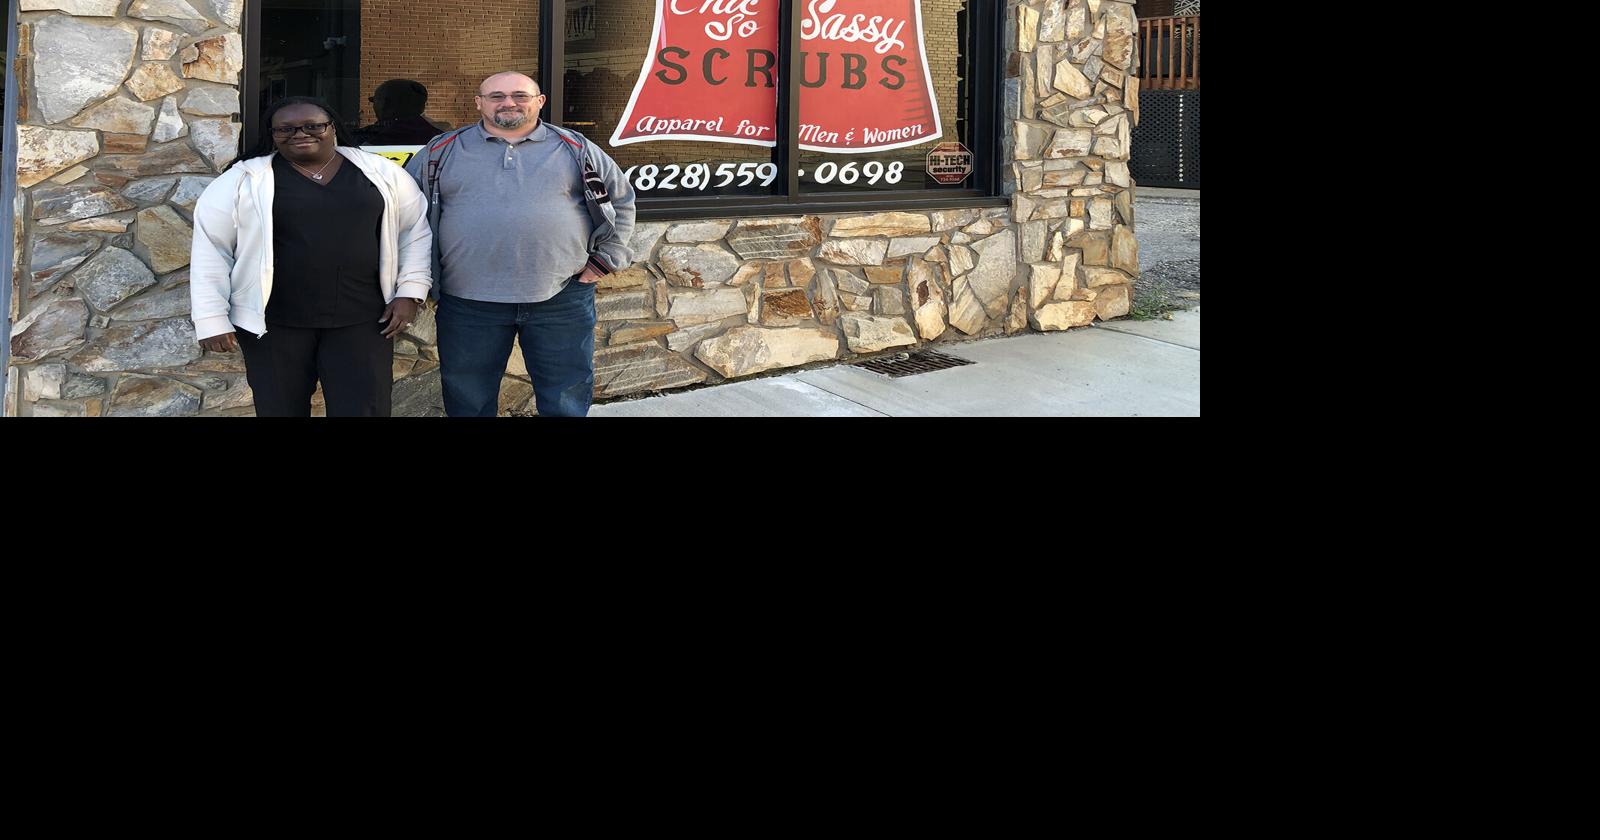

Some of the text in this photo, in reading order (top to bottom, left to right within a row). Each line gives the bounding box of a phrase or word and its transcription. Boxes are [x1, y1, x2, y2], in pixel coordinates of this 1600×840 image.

[704, 0, 906, 54] So Sassy
[636, 115, 724, 134] Apparel
[734, 119, 771, 137] for
[799, 124, 839, 144] Men
[863, 123, 924, 144] Women
[929, 154, 971, 166] HI-TECH
[932, 166, 967, 174] security
